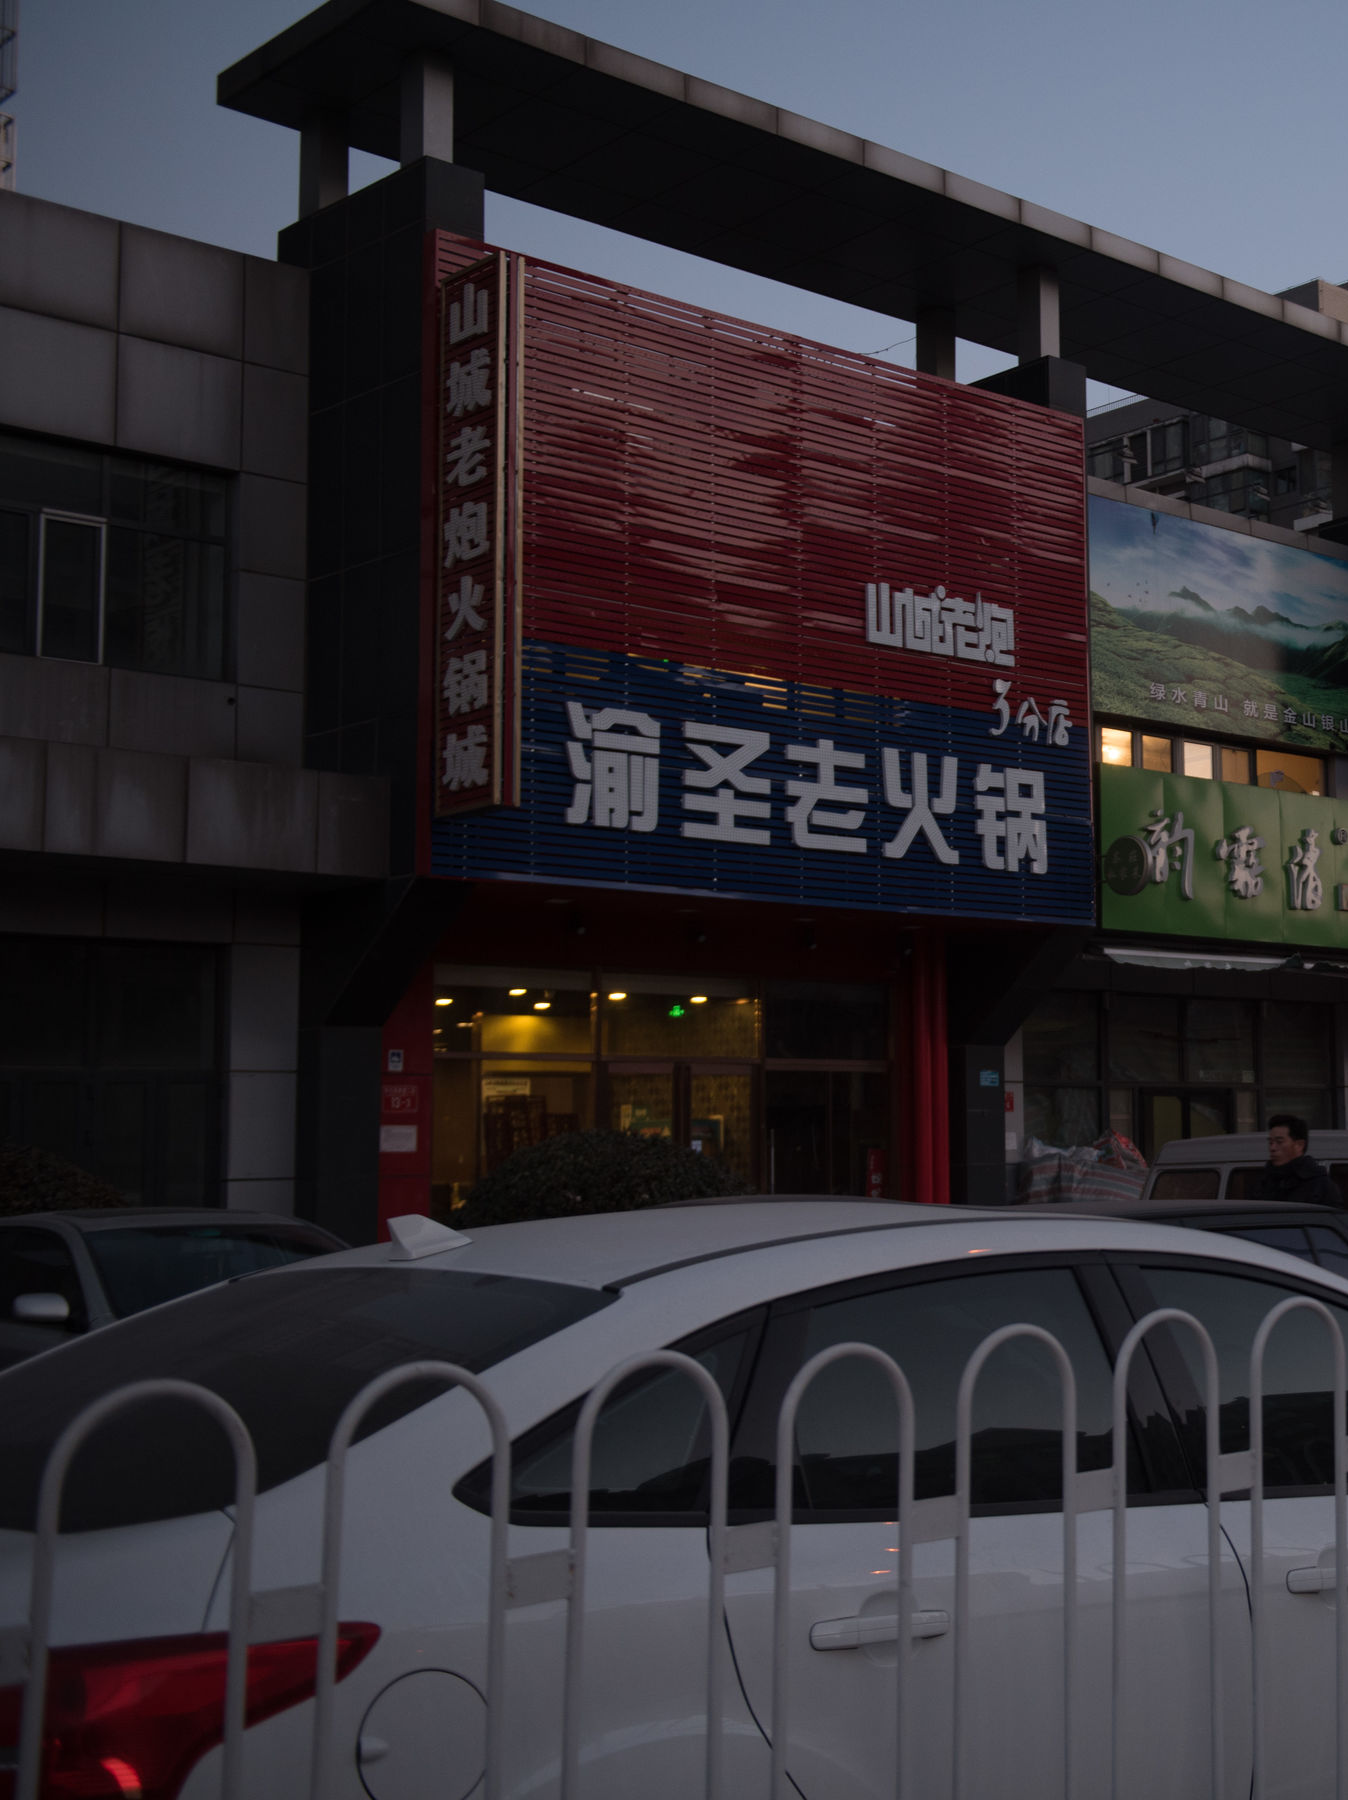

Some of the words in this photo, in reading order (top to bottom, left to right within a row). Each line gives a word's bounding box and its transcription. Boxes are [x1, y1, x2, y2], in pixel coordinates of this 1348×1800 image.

[442, 281, 493, 792] 山城老炮火锅城
[1150, 682, 1229, 713] 绿水青山
[565, 700, 1048, 875] 渝圣老火锅
